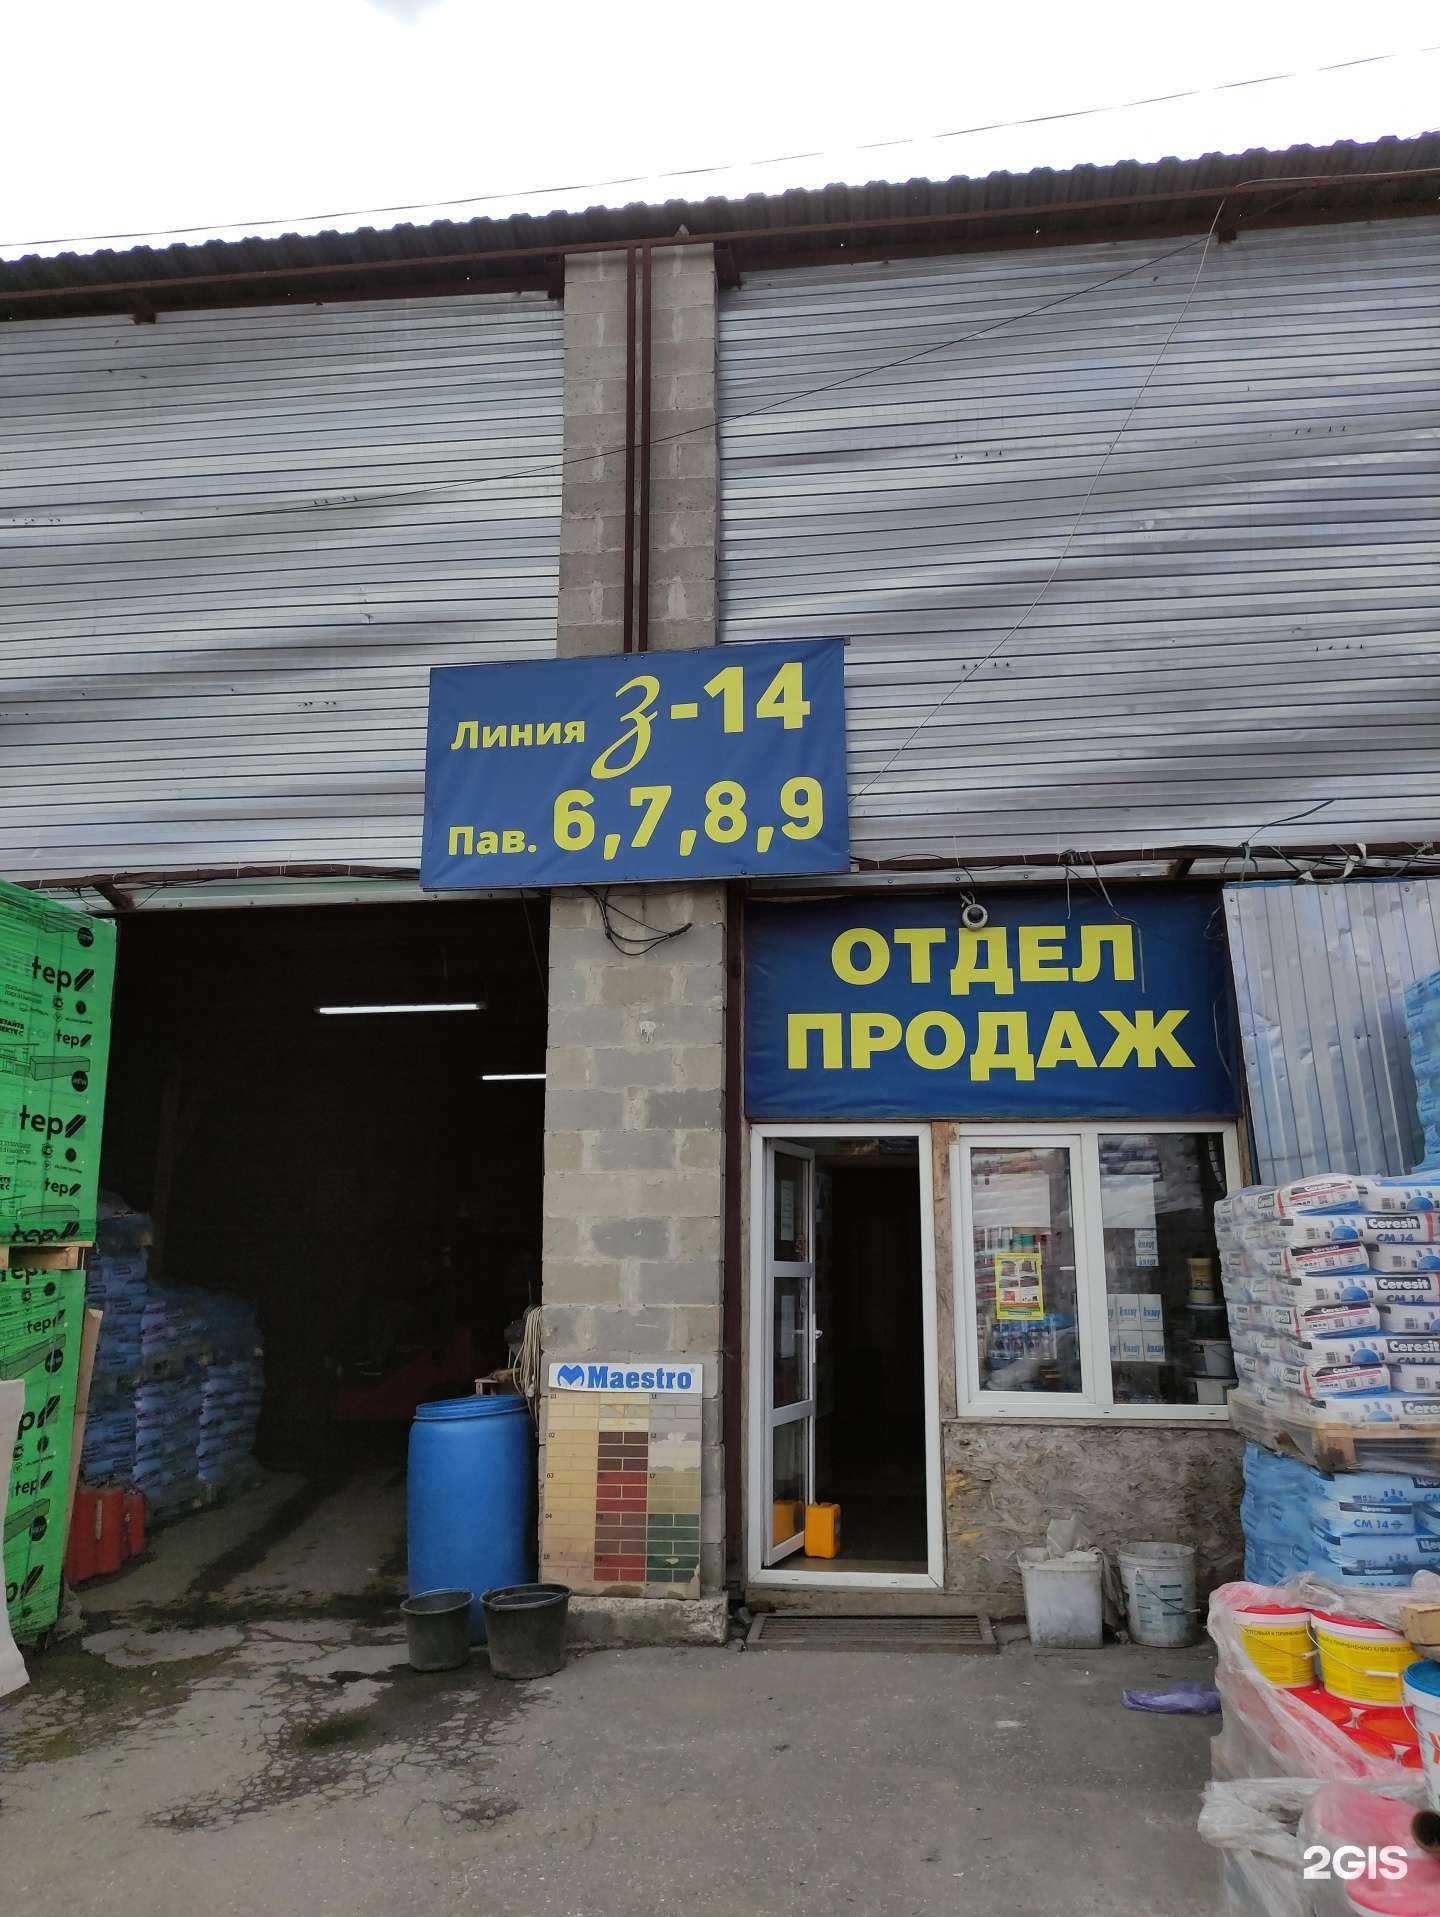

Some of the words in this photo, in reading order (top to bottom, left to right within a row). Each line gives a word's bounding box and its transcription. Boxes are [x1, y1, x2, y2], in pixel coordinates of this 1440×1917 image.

[450, 720, 586, 750] Линия
[448, 826, 537, 856] Пав.
[830, 924, 1135, 996] ОТДЕЛ
[787, 1010, 1196, 1081] ПРОДАЖ
[1367, 1217, 1418, 1230] Ceresit
[1378, 1278, 1429, 1291] Ceresit
[587, 1366, 692, 1389] Maestro
[1376, 1518, 1390, 1529] 14
